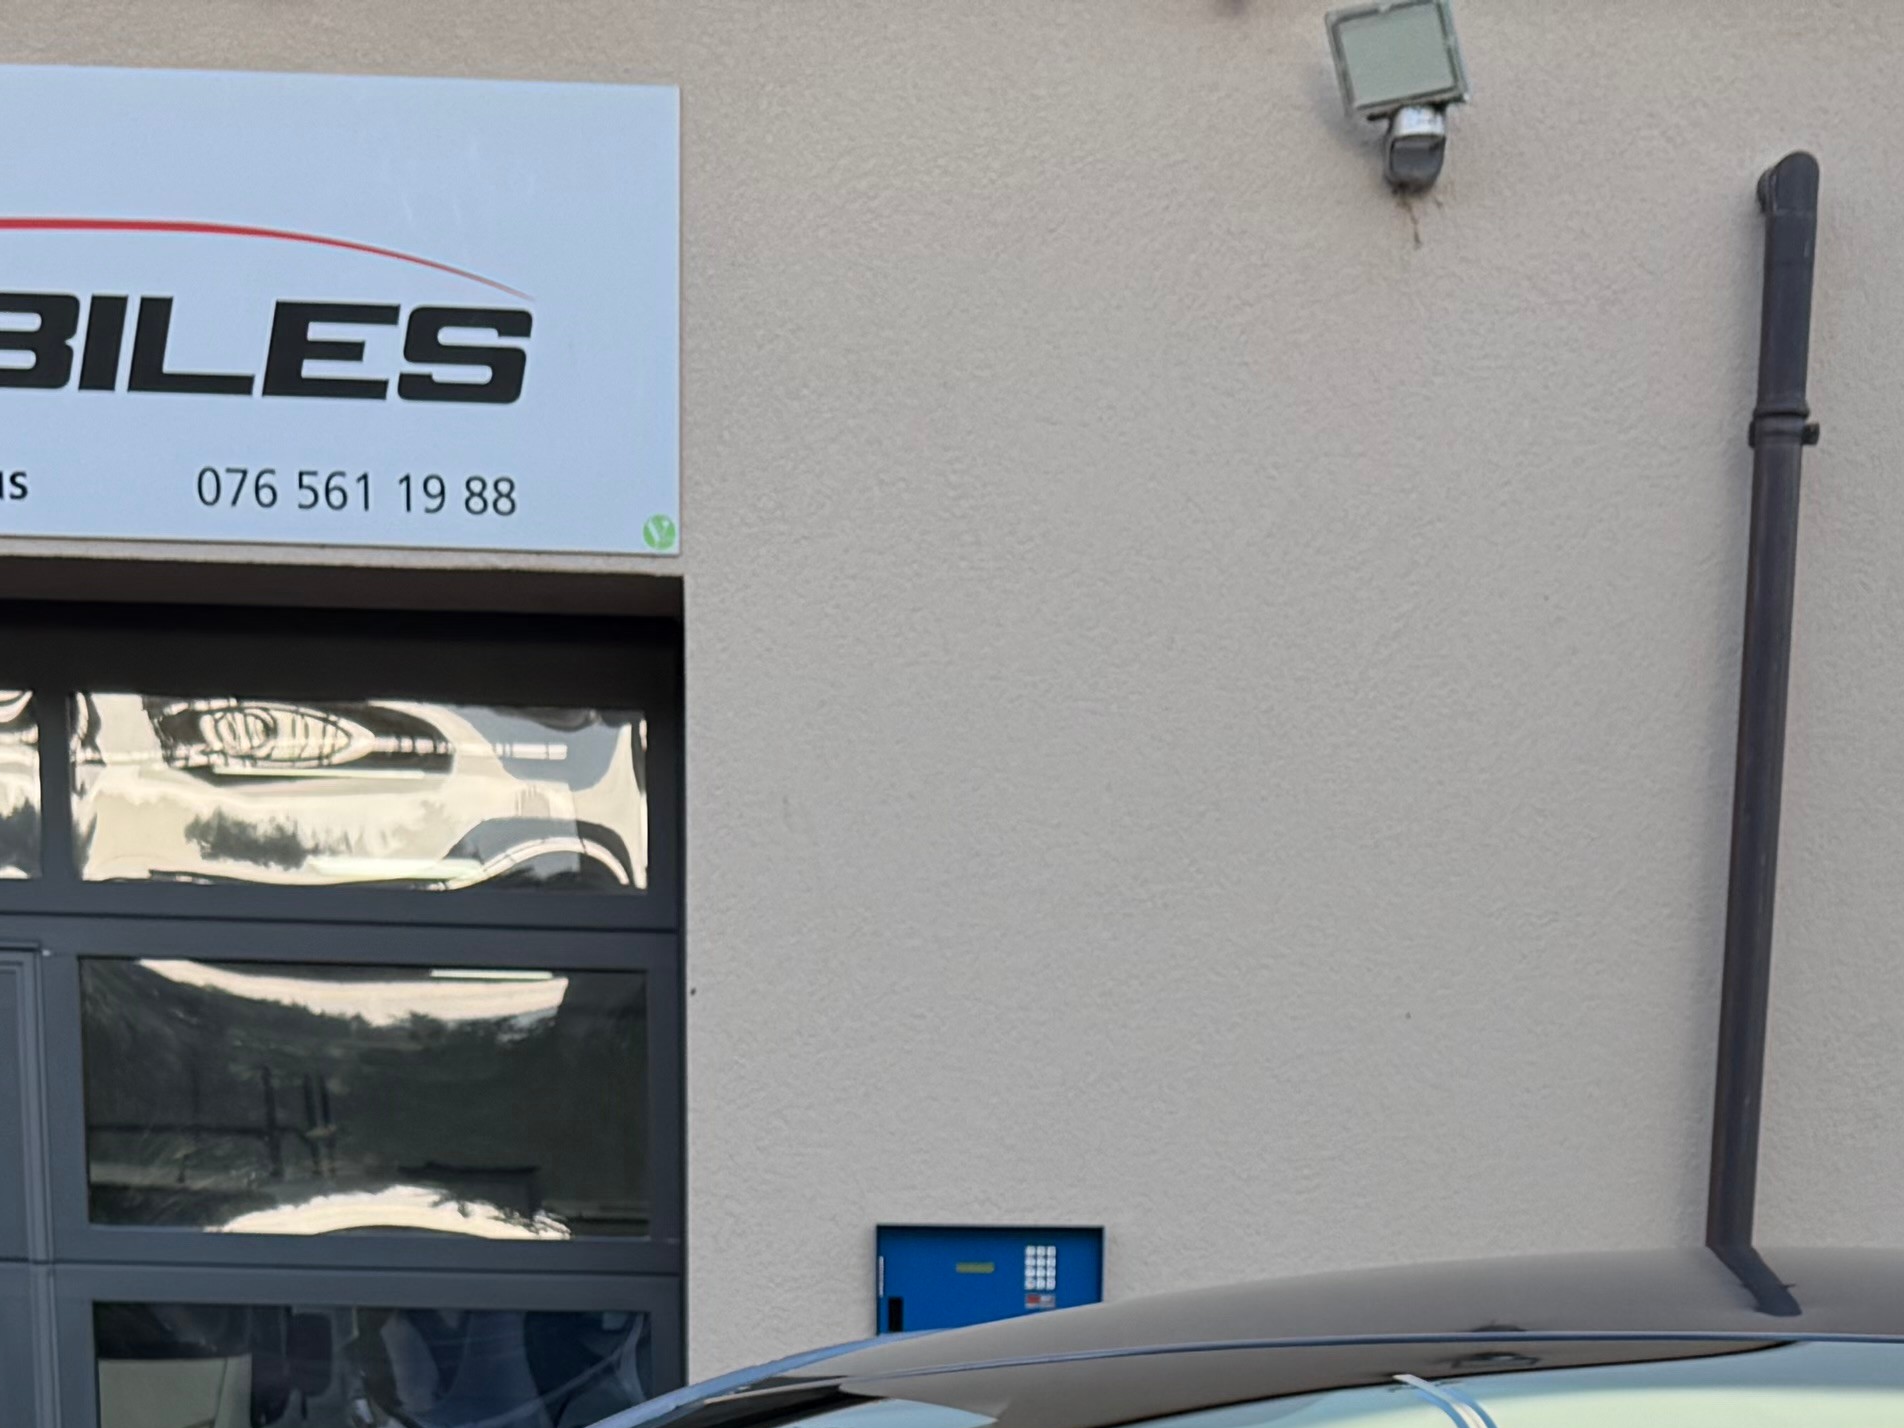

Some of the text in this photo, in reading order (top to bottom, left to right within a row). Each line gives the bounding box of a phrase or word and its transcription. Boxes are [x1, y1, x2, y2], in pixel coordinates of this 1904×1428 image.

[197, 466, 278, 509] 076
[297, 470, 371, 512] 561
[399, 473, 446, 514] 19
[464, 475, 517, 517] 88
